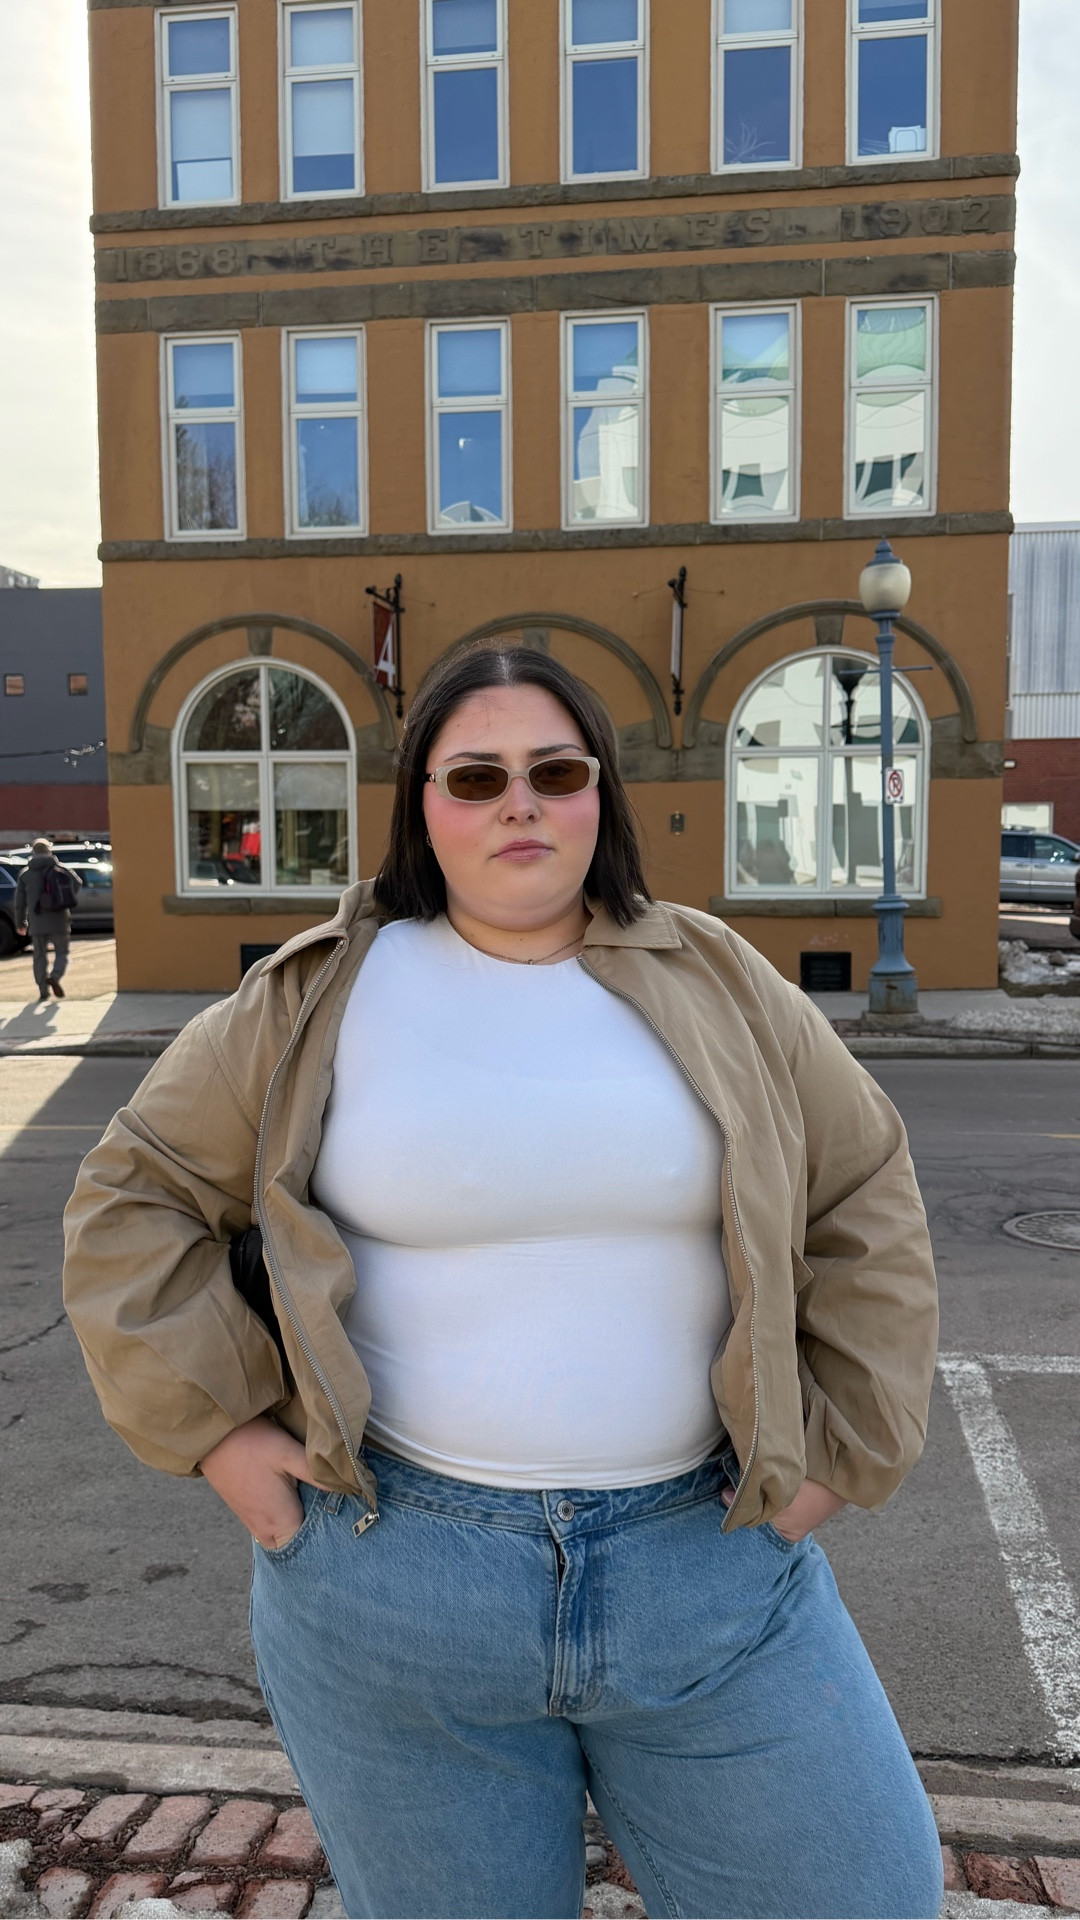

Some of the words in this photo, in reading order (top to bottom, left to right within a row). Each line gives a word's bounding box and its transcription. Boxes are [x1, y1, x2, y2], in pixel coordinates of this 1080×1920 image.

[114, 243, 238, 281] 1868
[305, 229, 449, 271] THE
[520, 208, 770, 257] TIMES
[851, 199, 991, 239] 1902
